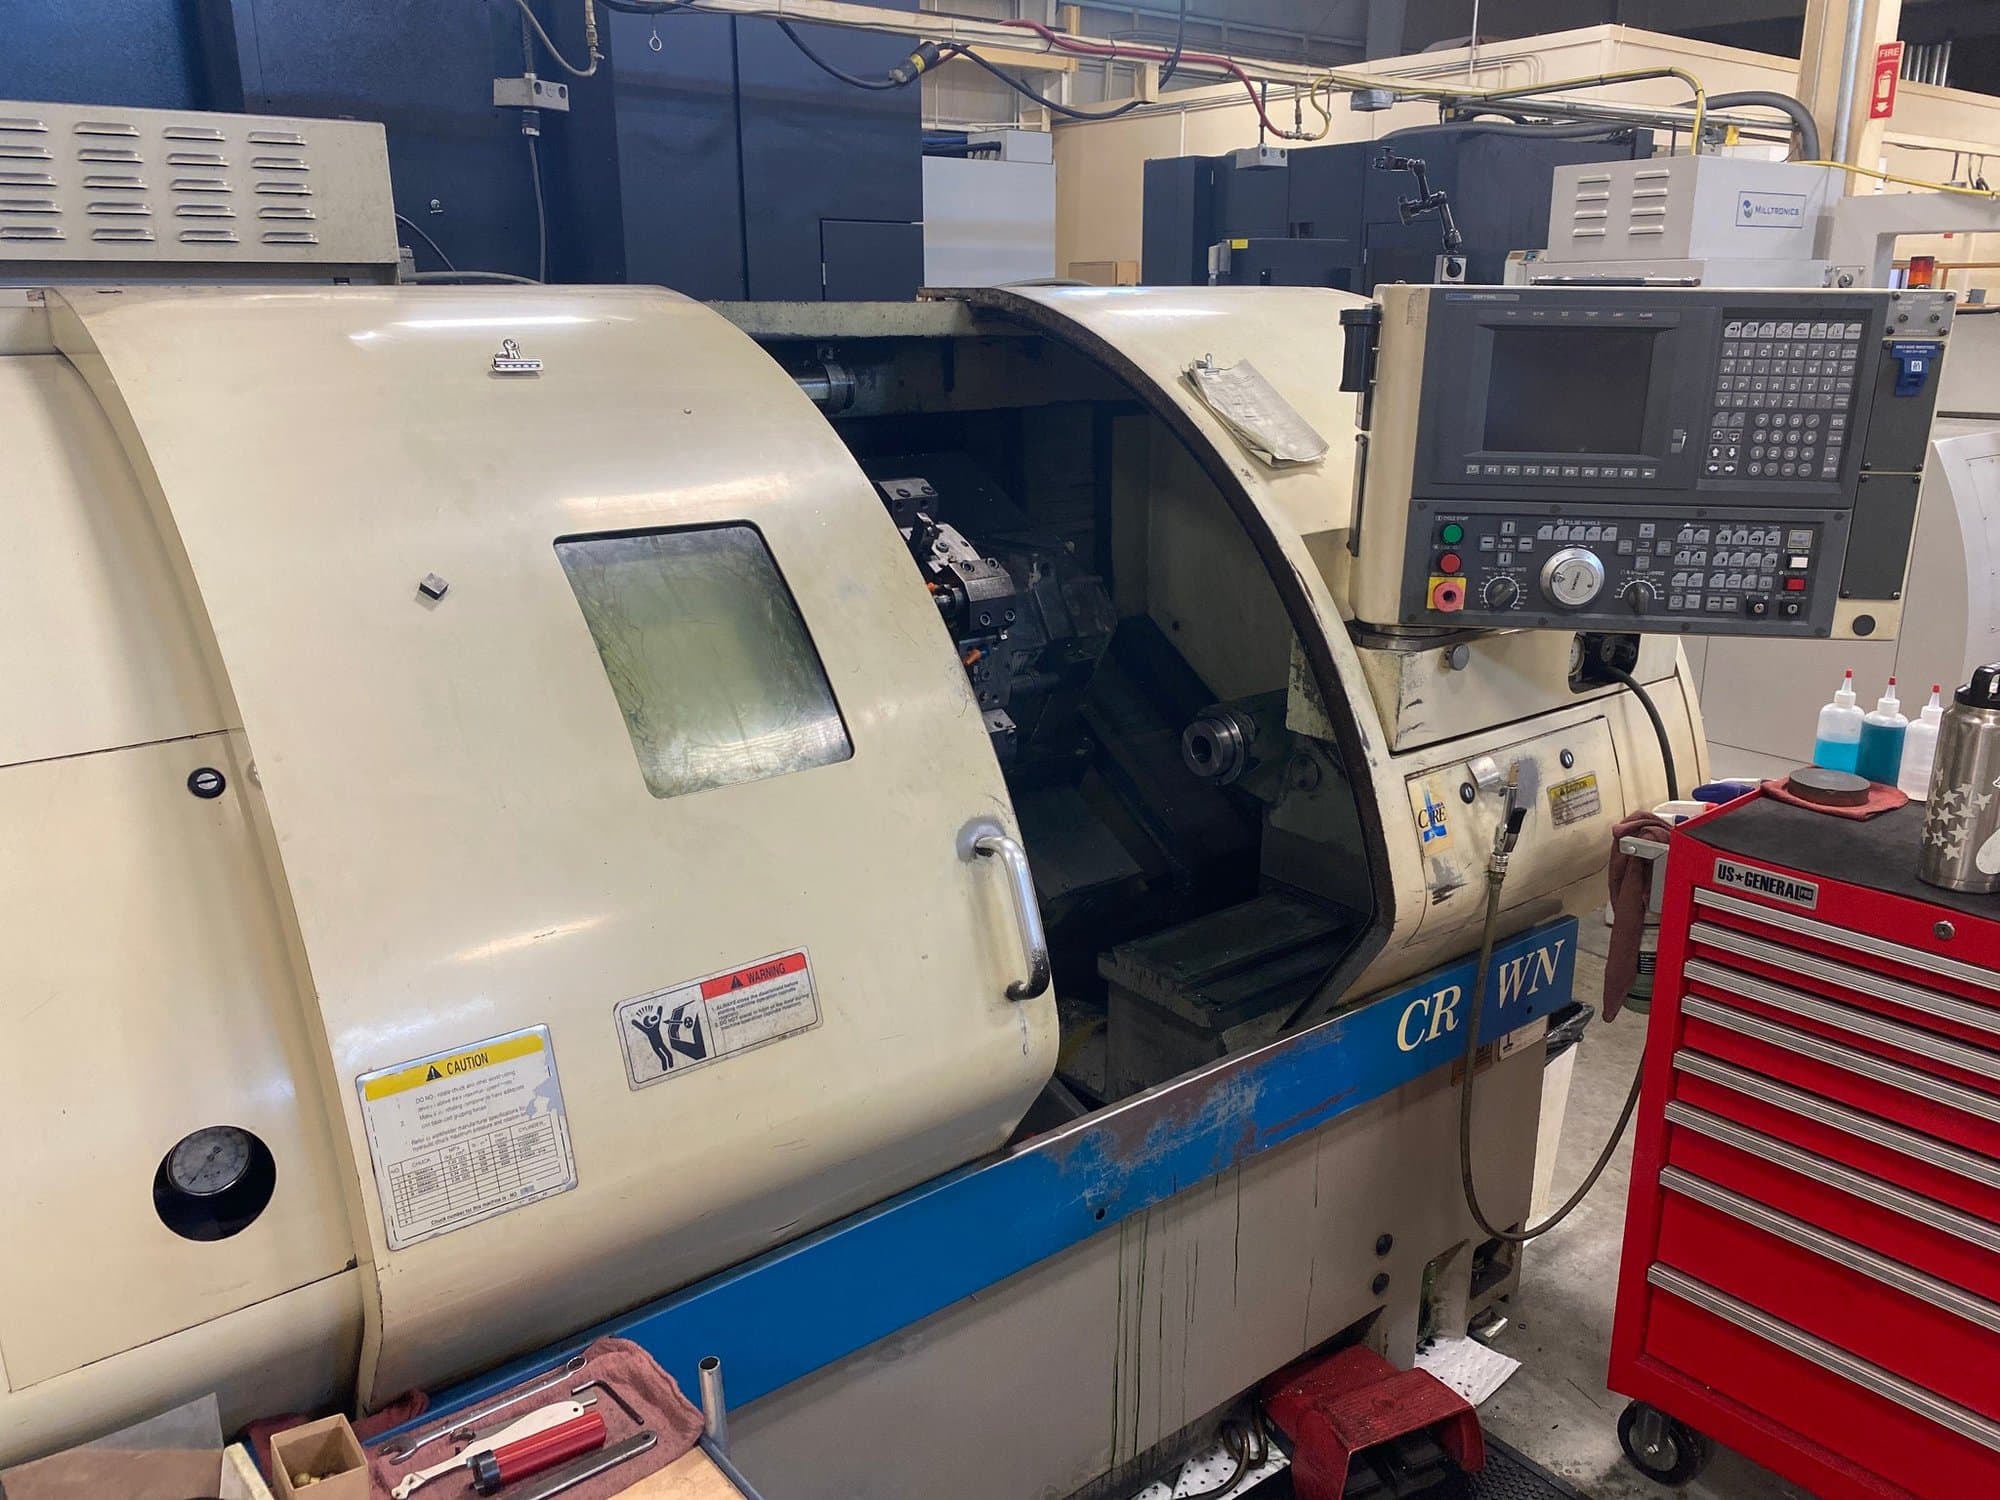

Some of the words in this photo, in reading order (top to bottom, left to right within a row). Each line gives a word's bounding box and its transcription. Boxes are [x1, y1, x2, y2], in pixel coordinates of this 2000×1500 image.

[1880, 48, 1900, 57] FIRE
[1718, 863, 1735, 882] US
[1744, 871, 1801, 901] GENERAL
[746, 963, 785, 983] WARNING
[1397, 938, 1567, 1052] CRWN
[447, 1053, 489, 1075] CAUTION
